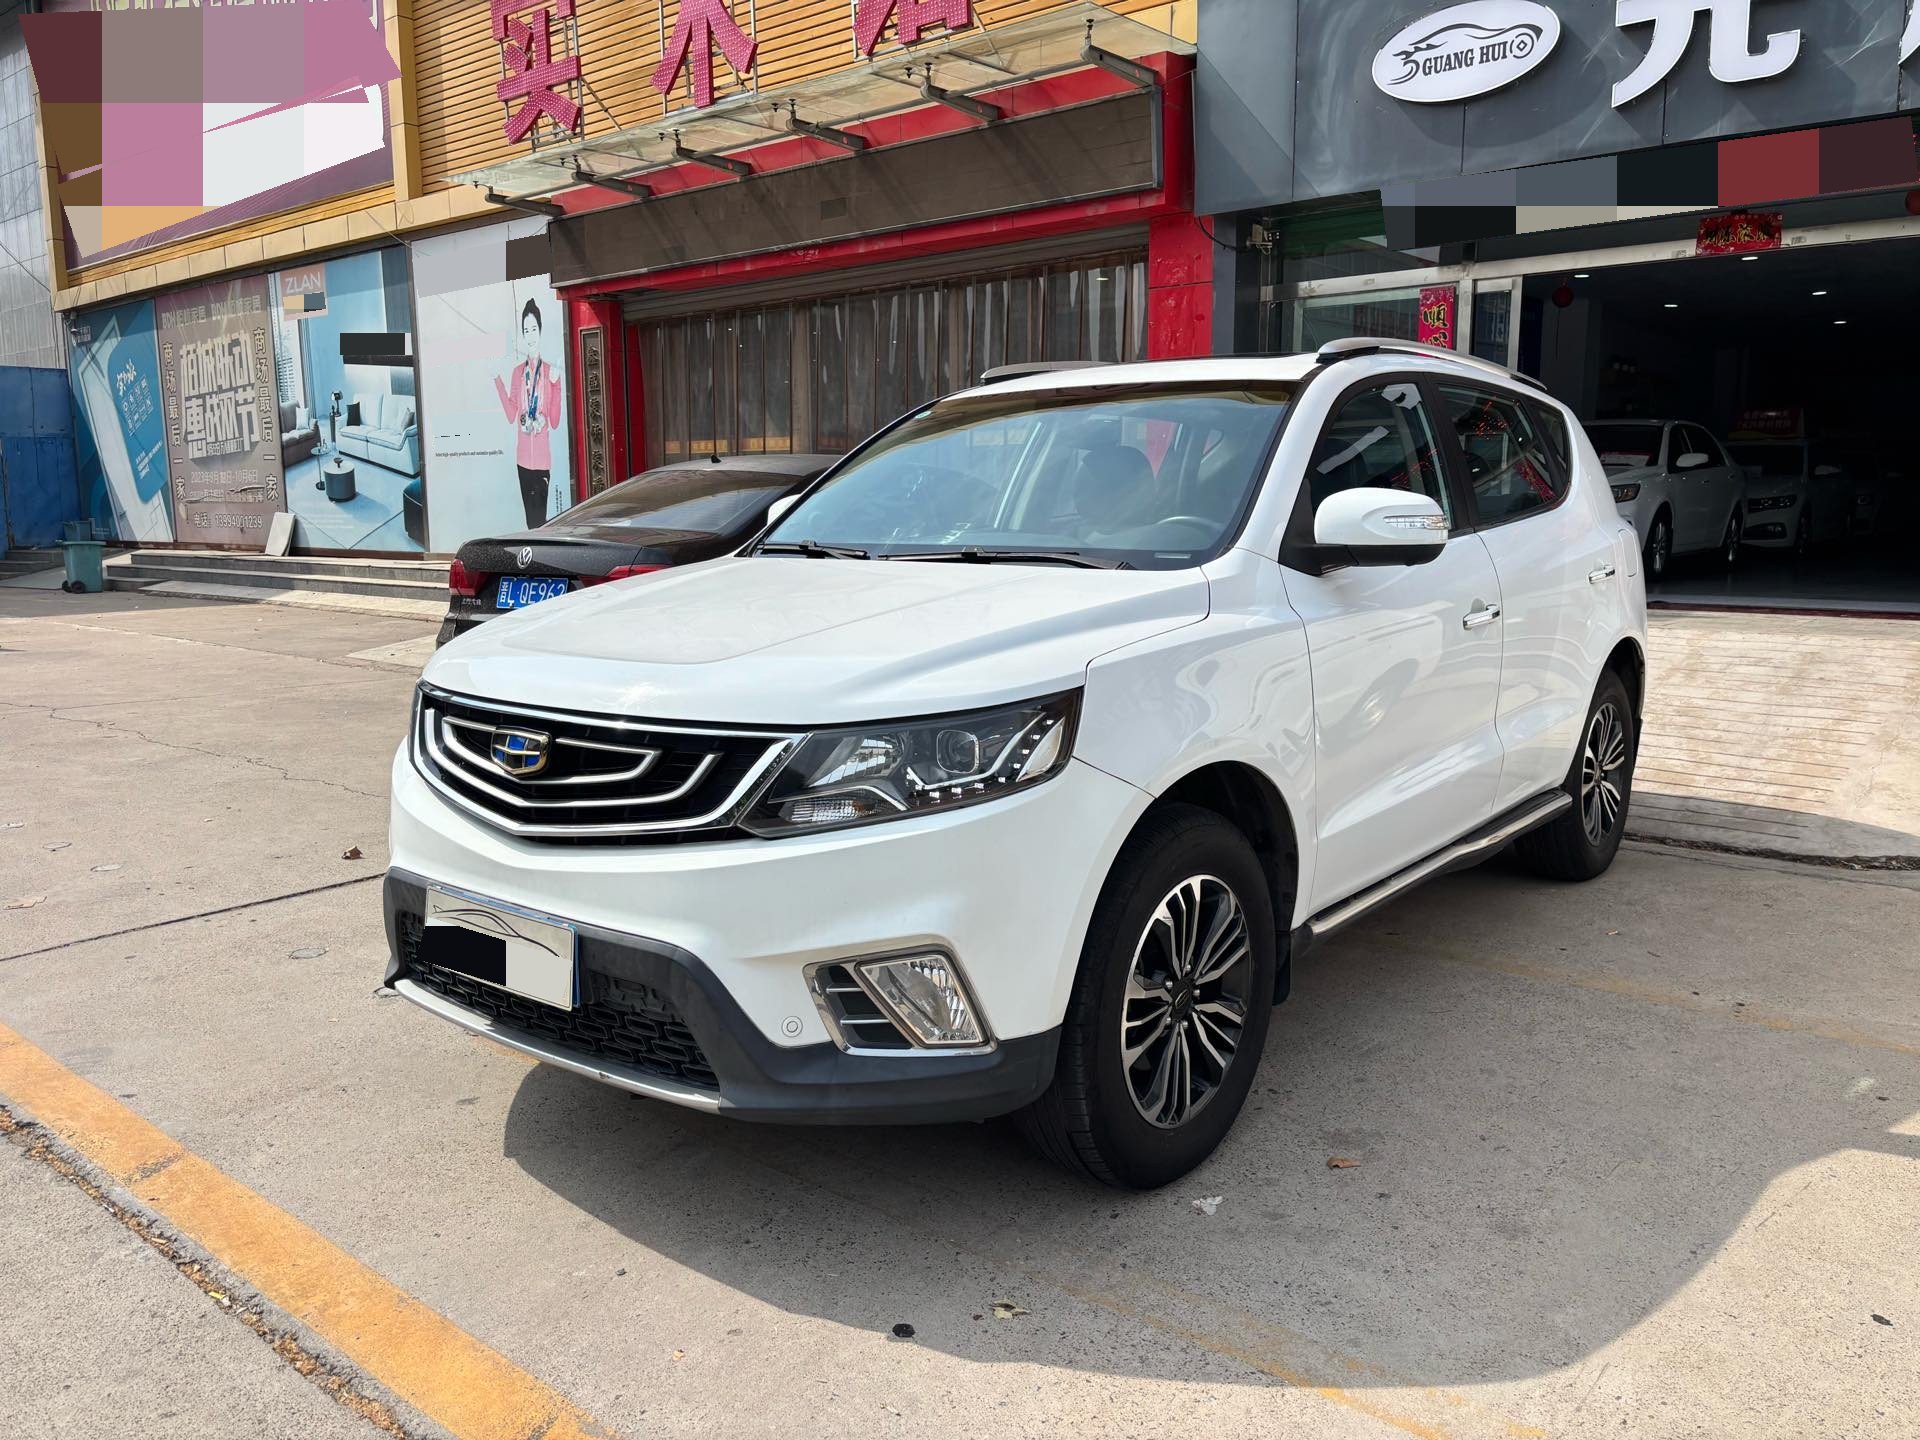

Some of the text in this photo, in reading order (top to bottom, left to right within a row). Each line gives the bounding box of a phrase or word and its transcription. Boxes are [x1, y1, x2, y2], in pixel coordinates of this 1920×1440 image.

[1421, 41, 1508, 77] GUANG HUI
[285, 271, 322, 294] ZLAN
[163, 341, 187, 501] 商场最后一家
[253, 326, 279, 501] 商场最后一家
